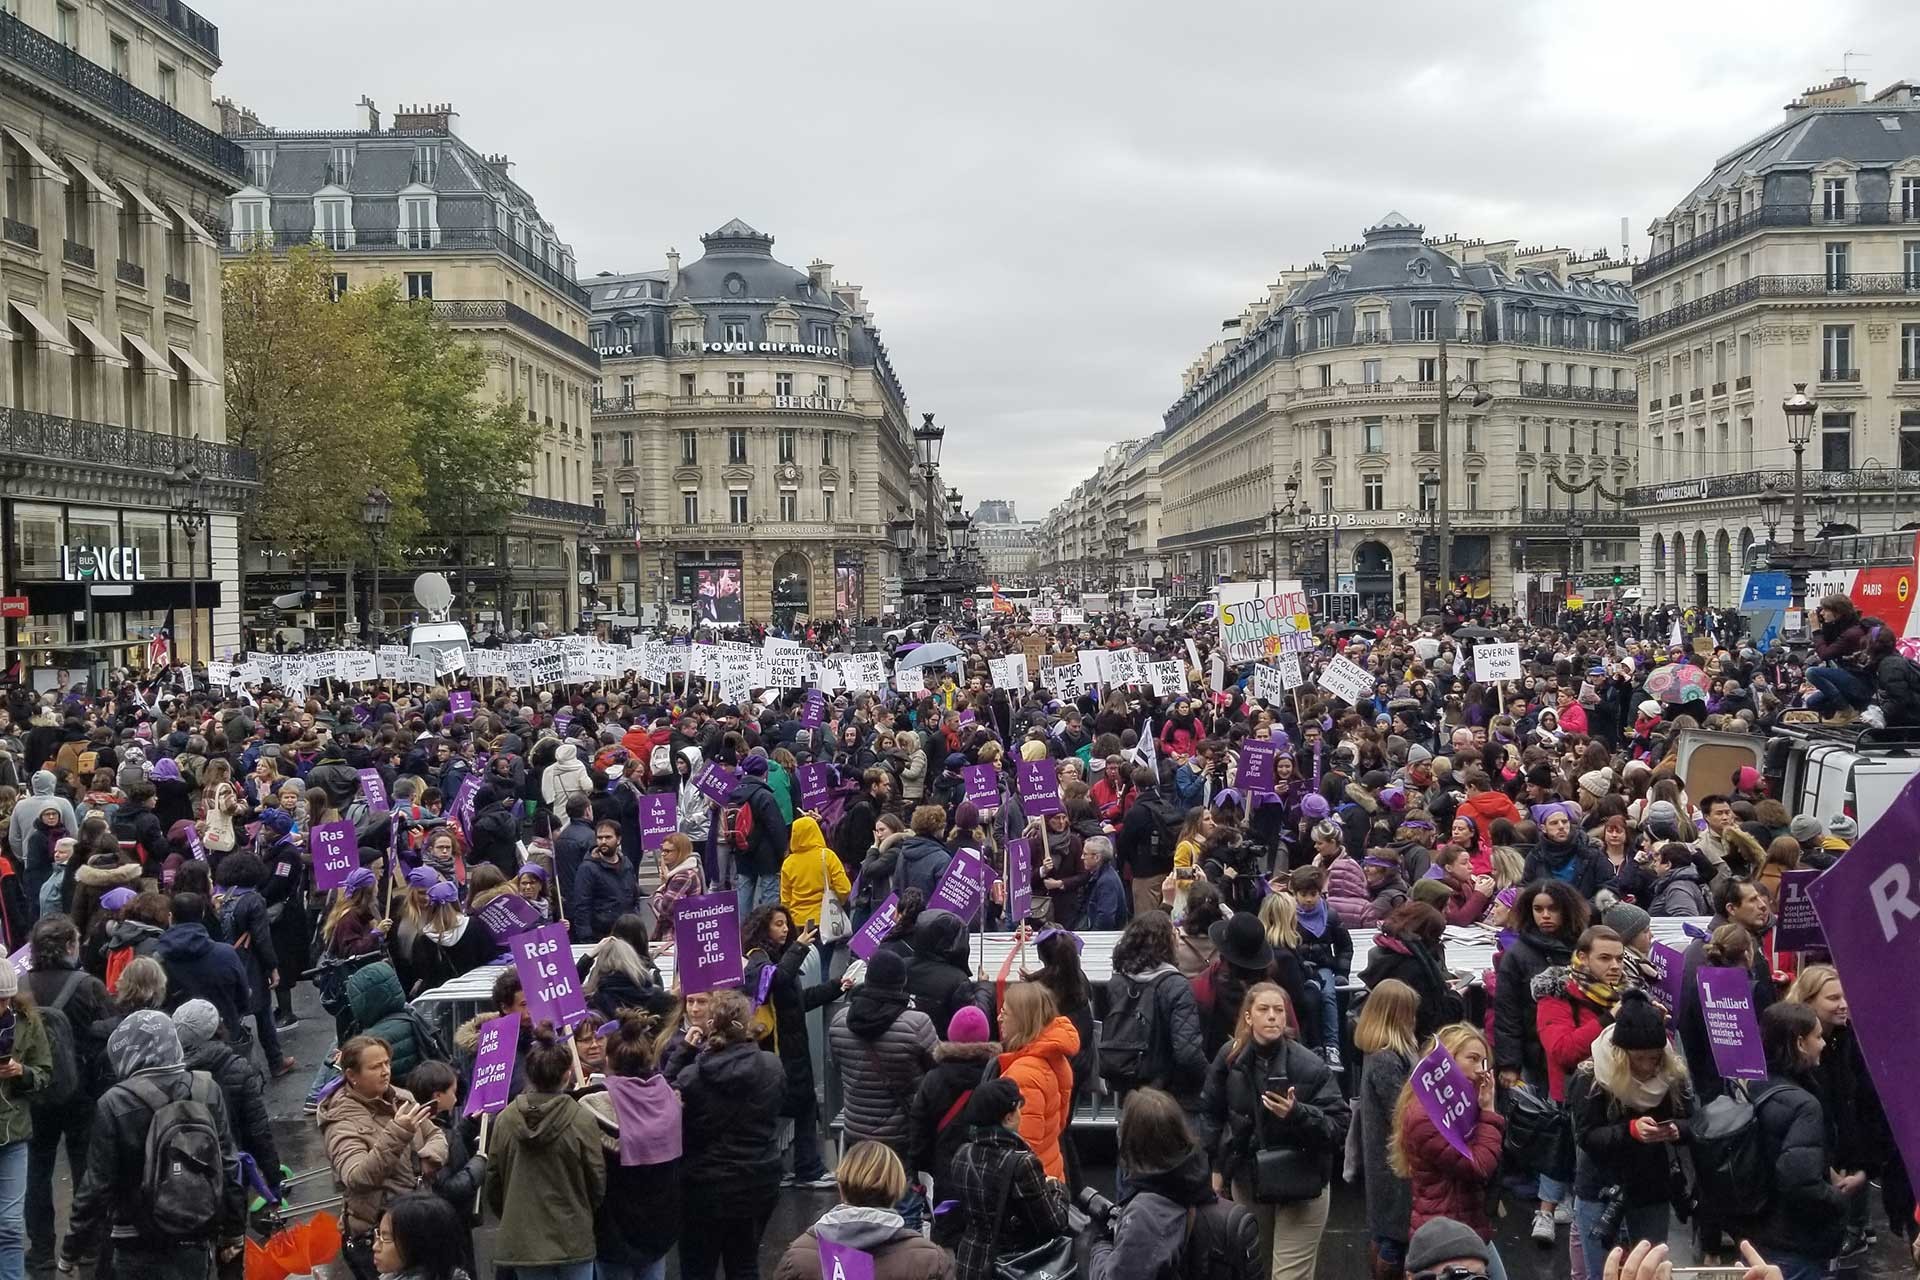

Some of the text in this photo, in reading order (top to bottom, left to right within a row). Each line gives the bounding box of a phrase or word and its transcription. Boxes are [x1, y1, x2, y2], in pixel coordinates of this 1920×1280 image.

[702, 341, 838, 356] royal air maroc
[1656, 484, 1700, 502] COMMERZBANK
[399, 546, 448, 555] MATY
[79, 556, 94, 565] BUS
[1806, 582, 1844, 597] PEN TOUR
[1862, 584, 1882, 595] PARIS
[1224, 592, 1307, 626] STOP CRIMES
[1224, 616, 1297, 644] VIOLENCES
[1280, 630, 1314, 652] FEMMES
[481, 651, 508, 660] AIMER
[722, 654, 752, 662] MARTINE
[1478, 648, 1515, 659] SEVERINE
[767, 658, 799, 667] LUCETTE
[1058, 663, 1083, 680] AIMER
[1335, 658, 1372, 687] COLLAGES
[1061, 686, 1081, 700] TUER
[1326, 676, 1355, 700] PARIS
[1032, 764, 1039, 773] À
[969, 789, 996, 800] patriarcat
[1024, 791, 1057, 802] patriarcat
[654, 798, 661, 807] À
[319, 830, 344, 842] Ras
[644, 825, 676, 836] patriarcat
[327, 844, 340, 855] le
[324, 856, 351, 871] viol
[952, 859, 966, 879] 1
[1786, 883, 1801, 903] 1
[494, 897, 527, 928] 1 milliard
[678, 904, 735, 921] Féminicides
[697, 919, 718, 933] pas
[697, 931, 720, 942] une
[524, 939, 558, 960] Ras
[703, 941, 718, 952] de
[698, 952, 725, 968] plus
[537, 961, 558, 978] le
[538, 976, 572, 1002] viol
[1702, 982, 1749, 1010] 1 milliard
[1707, 1012, 1737, 1021] contre les
[1709, 1020, 1738, 1029] violences
[490, 1030, 498, 1040] te
[1711, 1028, 1744, 1038] sexistes et
[480, 1040, 499, 1055] crois
[1713, 1036, 1742, 1046] sexuelles
[478, 1067, 484, 1077] Tu
[496, 1062, 506, 1071] es
[1421, 1057, 1451, 1092] Ras
[474, 1072, 505, 1090] pour rien
[1435, 1084, 1454, 1105] le
[1442, 1091, 1471, 1129] viol
[832, 1255, 846, 1280] À
